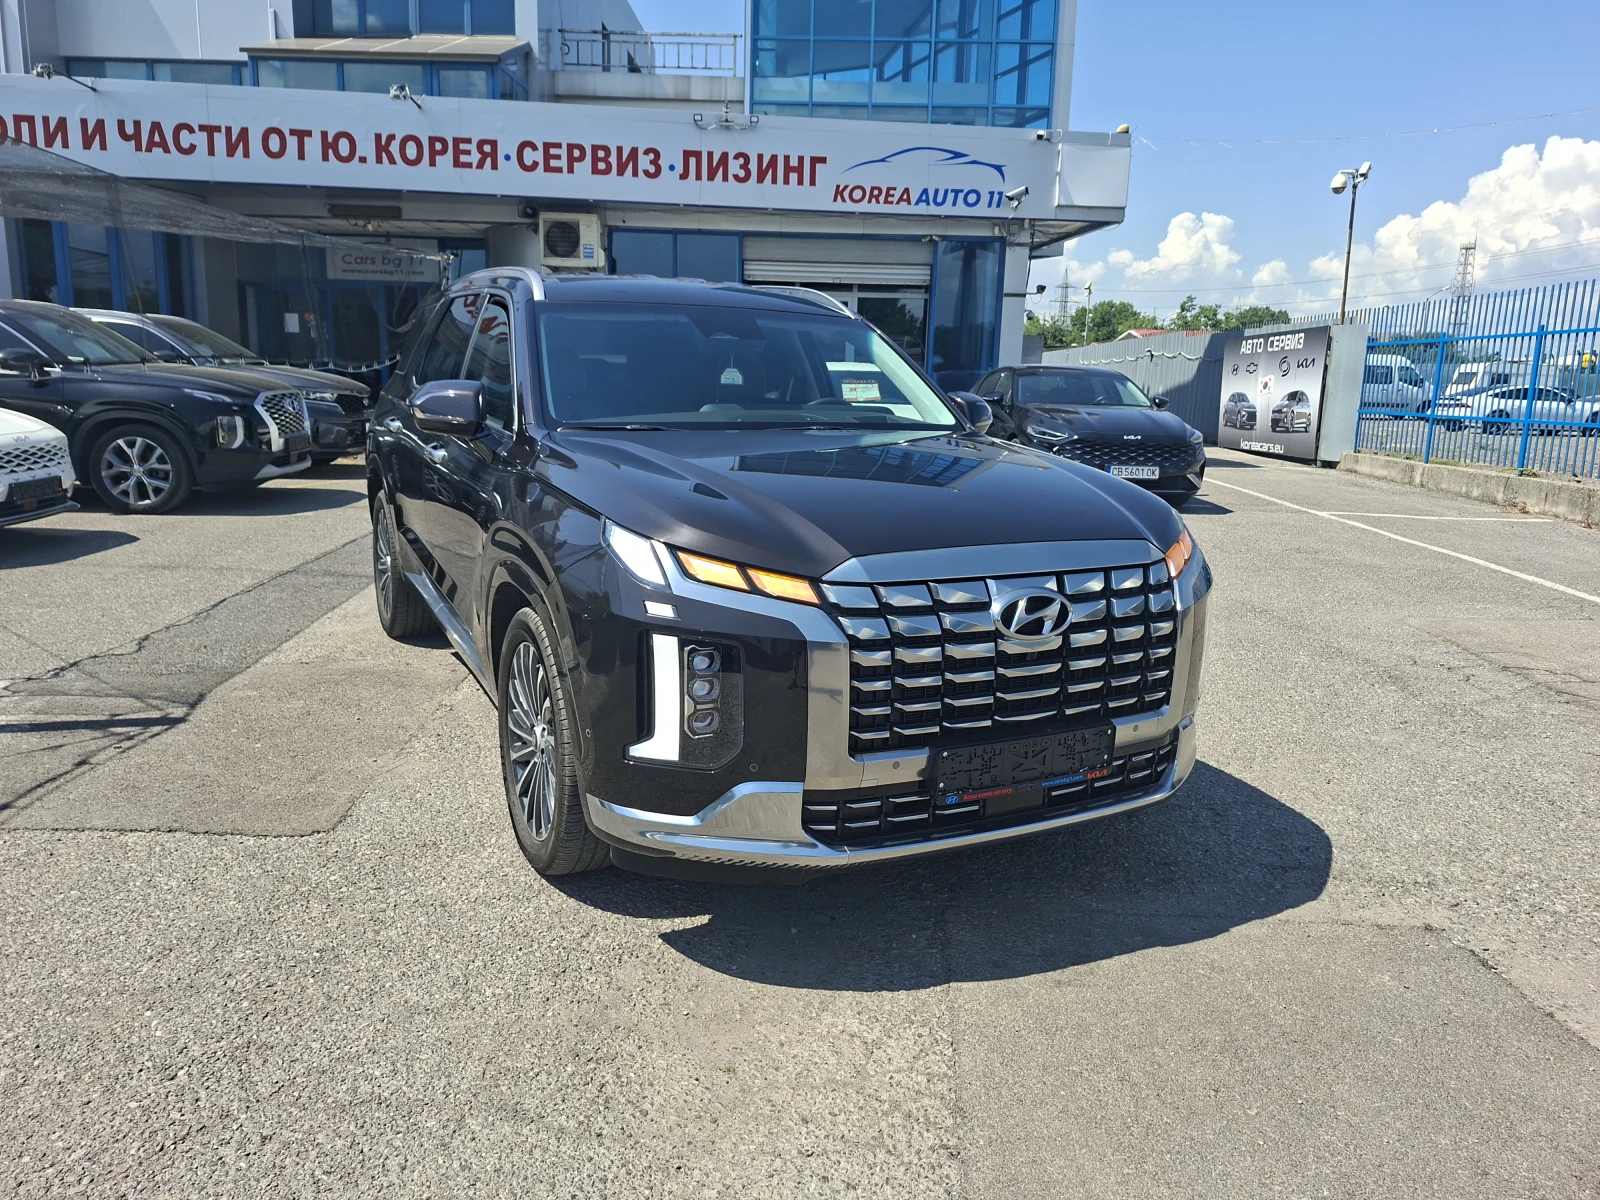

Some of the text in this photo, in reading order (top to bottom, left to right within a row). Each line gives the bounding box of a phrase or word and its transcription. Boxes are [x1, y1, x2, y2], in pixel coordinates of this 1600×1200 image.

[79, 117, 108, 151] И
[116, 118, 251, 159] ЧАСТИ
[260, 126, 313, 161] ОТ
[374, 132, 499, 171] КОРЕЯ
[516, 140, 663, 180] СЕРВИЗ
[679, 149, 828, 187] ЛИЗИНГ
[986, 190, 1004, 209] 11
[341, 253, 377, 266] Cars
[381, 254, 402, 268] bg
[341, 267, 425, 276] www.carsbg11.com
[1239, 332, 1305, 355] АВТО СЕРВИЗ
[1240, 437, 1285, 454] koreacars.eu
[1124, 467, 1145, 477] 5601
